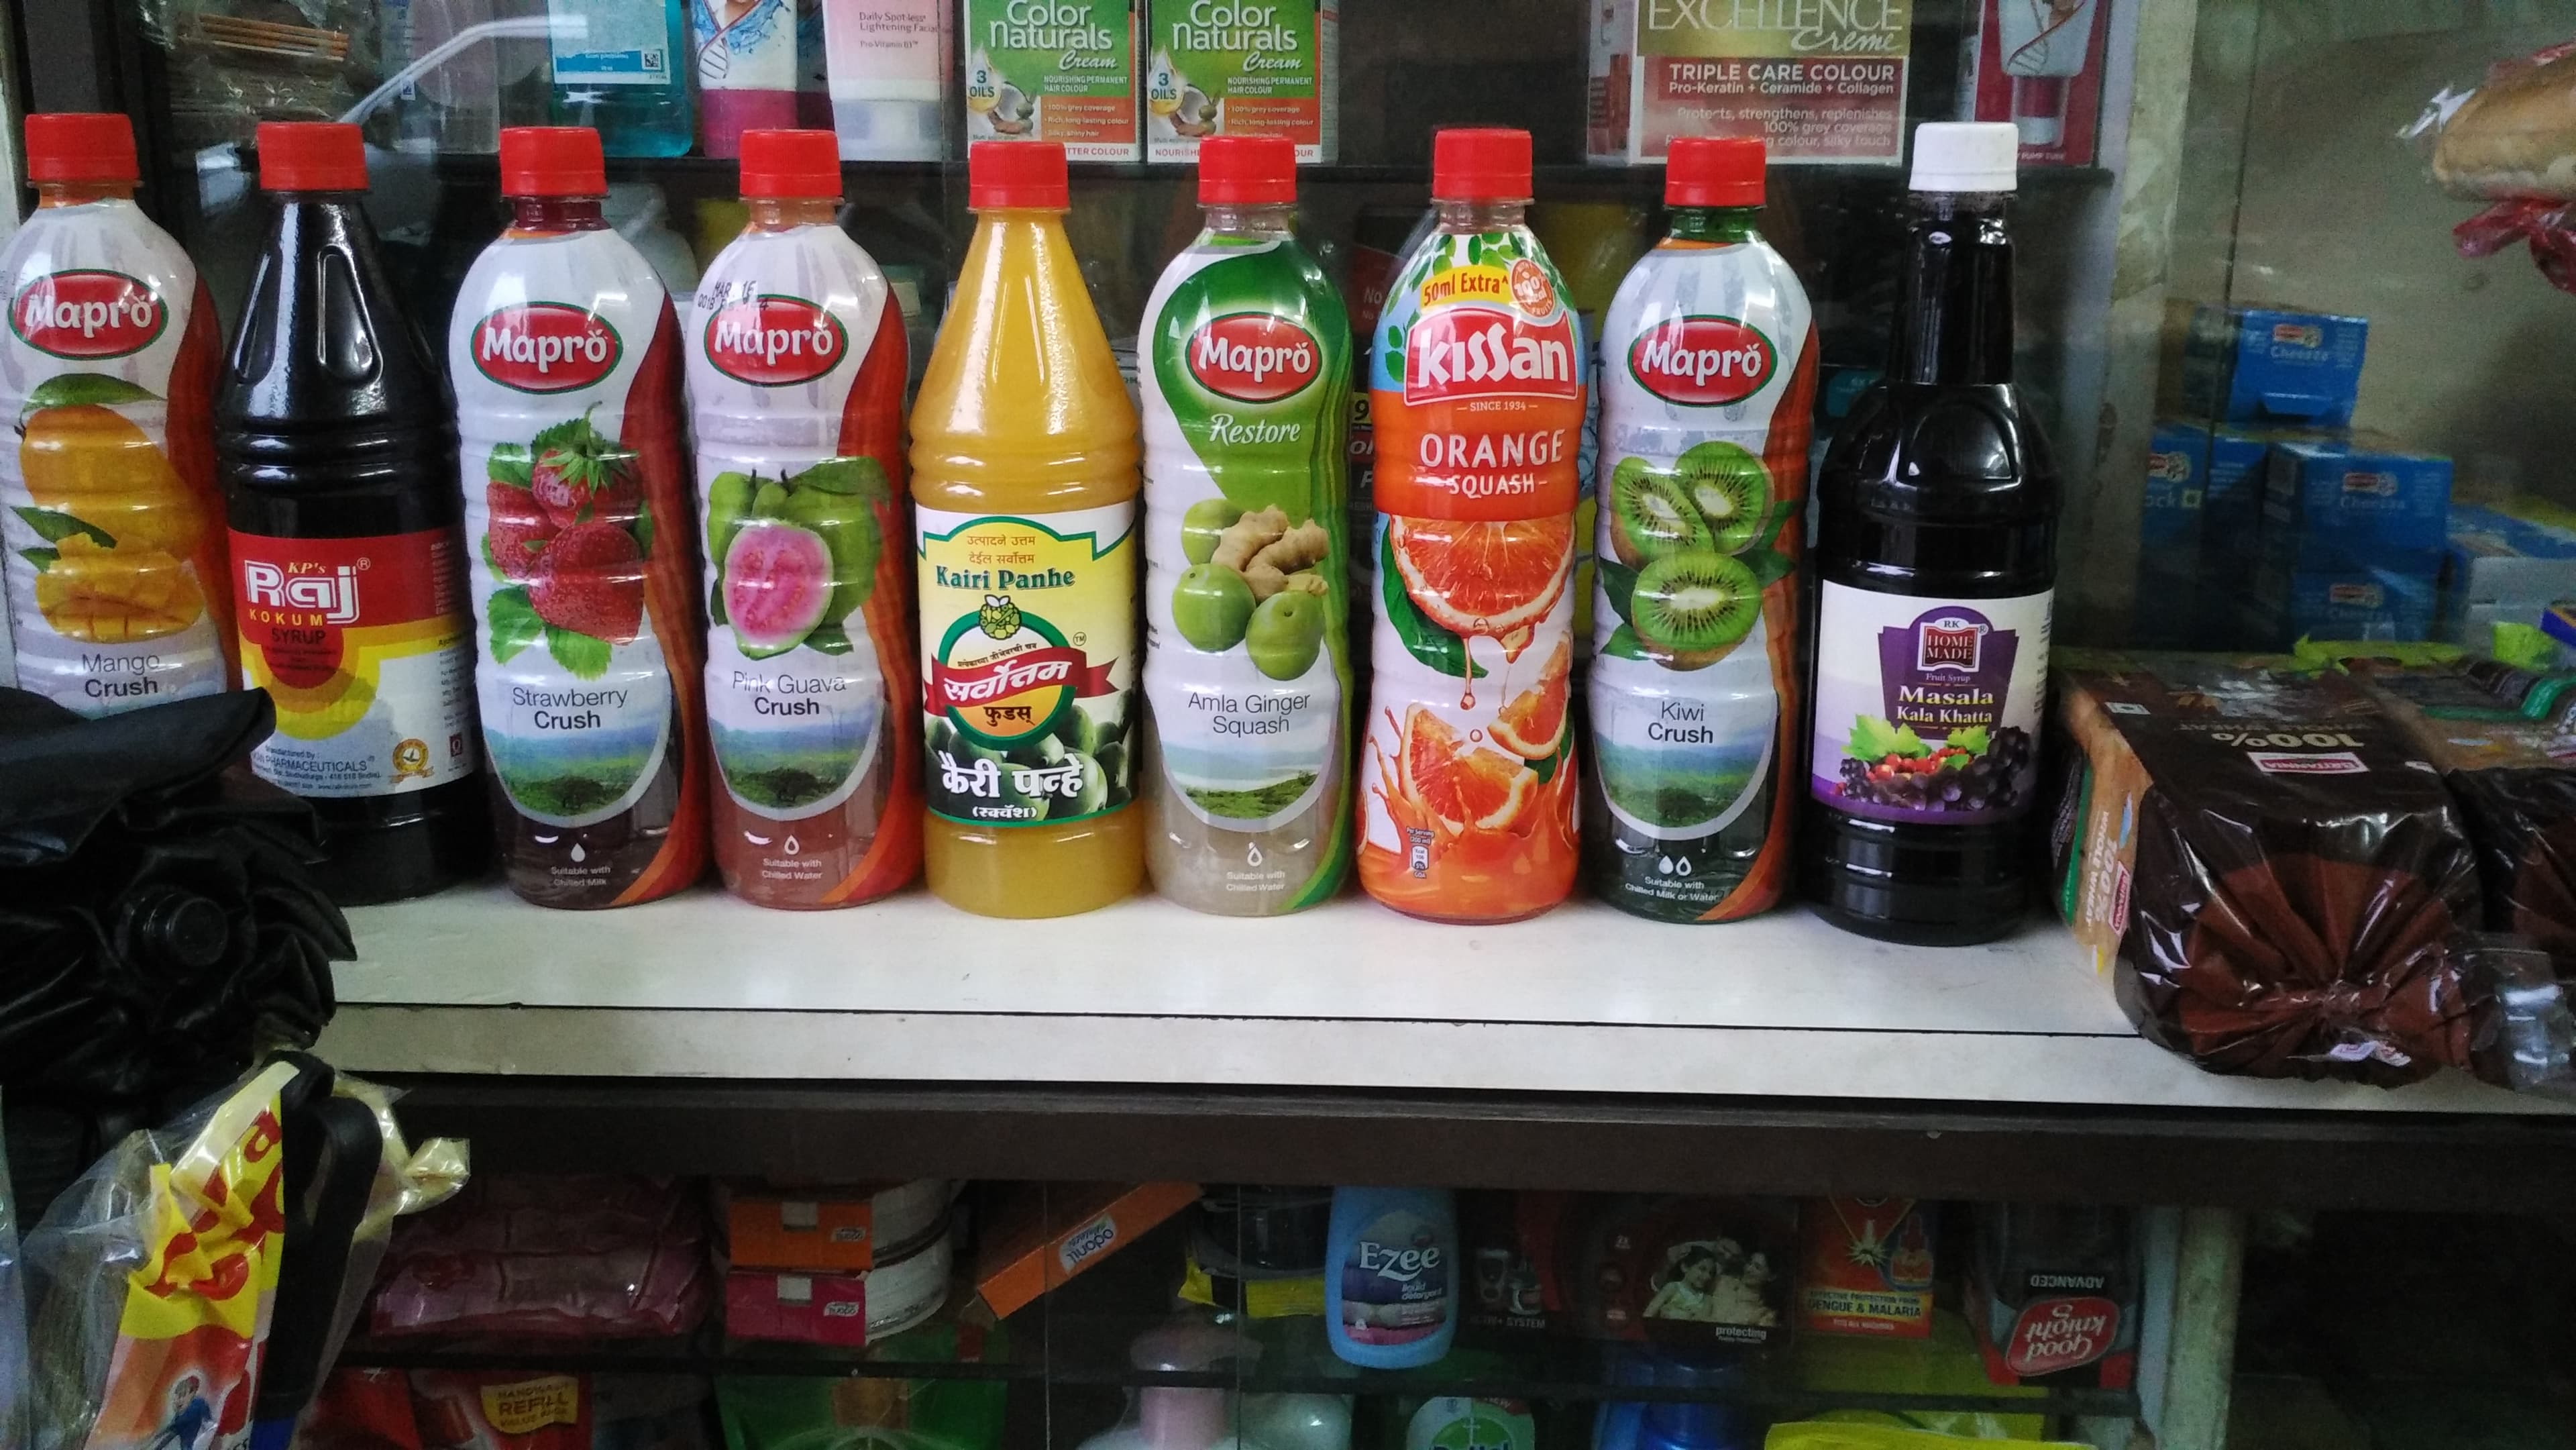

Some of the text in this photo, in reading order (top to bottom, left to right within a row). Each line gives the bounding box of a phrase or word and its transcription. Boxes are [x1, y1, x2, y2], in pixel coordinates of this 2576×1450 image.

[859, 12, 883, 21] Daily
[1007, 0, 1092, 27] Color
[1190, 0, 1277, 28] Color
[1649, 0, 1902, 31] EXCELLENCE
[860, 23, 912, 34] Lightening
[1059, 50, 1117, 70] Cream
[1243, 51, 1303, 72] Cream
[976, 70, 987, 84] 3
[1044, 75, 1128, 84] NOURISHING PERMANENT
[1159, 72, 1169, 86] 3
[1669, 64, 1895, 81] TRIPLE CARE COLOUR
[1044, 85, 1088, 93] HAIR COLOUR
[1228, 77, 1270, 85] NOURISHING
[1669, 81, 1894, 96] Pro-Keratin Ceramide Collagen
[969, 87, 996, 99] OILS
[1150, 88, 1177, 100] OILS
[1228, 86, 1244, 94] HAIR
[1764, 121, 1892, 135] 100% grey coverage
[1824, 136, 1851, 148] silky
[1856, 136, 1890, 146] touch
[1424, 273, 1455, 306] 50ml
[1469, 399, 1527, 412] SINCE 1934
[1208, 413, 1301, 445] Restore
[1419, 429, 1564, 470] ORANGE
[1449, 473, 1536, 499] SQUASH
[967, 535, 1036, 546] उत्पादने उत्तम
[288, 562, 327, 574] KP's
[936, 566, 1075, 590] Kairi Panhe
[244, 560, 360, 625] Raj
[250, 608, 323, 626] KOKUM
[1943, 620, 1960, 629] RK
[272, 627, 326, 645] SYRUP
[1927, 635, 1974, 648] HOME
[1926, 647, 1973, 660] MADE
[81, 653, 161, 676] Mango
[732, 670, 847, 694] Pink Guava
[944, 660, 1073, 702] सर्वोत्तम
[1926, 673, 1971, 683] Fruit Syrup
[85, 678, 159, 698] Crush
[1898, 685, 1994, 705] Masala
[512, 687, 629, 709] Strawberry
[753, 696, 820, 716] Crush
[1188, 692, 1311, 718] Amla Ginger
[1660, 701, 1705, 721] Kiwi
[1896, 705, 1992, 724] Kala Khatta
[534, 711, 601, 730] Crush
[1213, 716, 1290, 737] Squash
[1648, 723, 1714, 744] Crush
[2210, 733, 2367, 747] 100%
[938, 750, 1083, 798] कैरी पन्हे
[551, 866, 611, 875] Suitable with
[763, 858, 822, 868] Suitable with
[553, 878, 607, 886] Chilled Milk
[761, 870, 823, 880] Chilled Water
[1226, 871, 1285, 881] Suitable with
[1644, 876, 1705, 890] Suitable with
[1226, 882, 1285, 892] Chilled Water
[1625, 883, 1654, 896] Chilled
[1656, 889, 1676, 900] Milk
[1689, 893, 1718, 902] Water
[1359, 1241, 1442, 1282] Ezee
[2030, 1275, 2105, 1288] ADVANCED
[1856, 1303, 1865, 1313] &
[1869, 1304, 1921, 1316] MALARIA
[1506, 1316, 1546, 1329] SYSTEM
[2025, 1304, 2108, 1343] knight
[1715, 1326, 1768, 1340] protecting
[2024, 1333, 2094, 1363] Good
